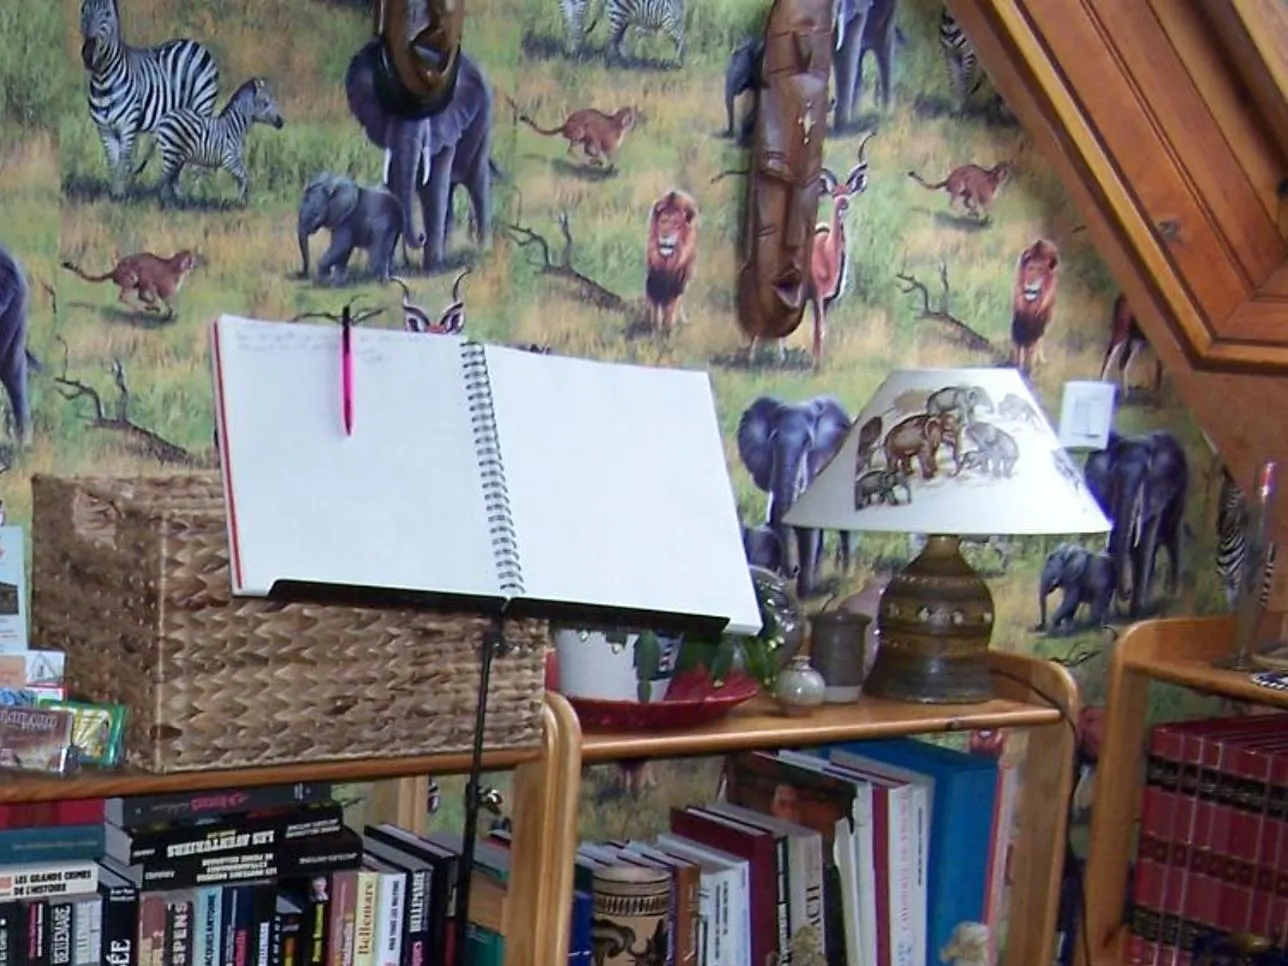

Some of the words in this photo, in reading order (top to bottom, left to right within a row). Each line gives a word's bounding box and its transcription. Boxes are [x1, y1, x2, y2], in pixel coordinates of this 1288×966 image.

[253, 830, 275, 844] LES
[13, 885, 24, 896] DE
[26, 883, 67, 894] L'HISTOIRE
[15, 875, 28, 885] LES
[30, 872, 62, 883] GRANDS
[65, 870, 92, 881] CRIMES
[205, 894, 216, 933] ANTOINE
[358, 881, 374, 956] Bellemare
[409, 871, 425, 933] BELLEMARE
[53, 905, 70, 964] BELLEMARE
